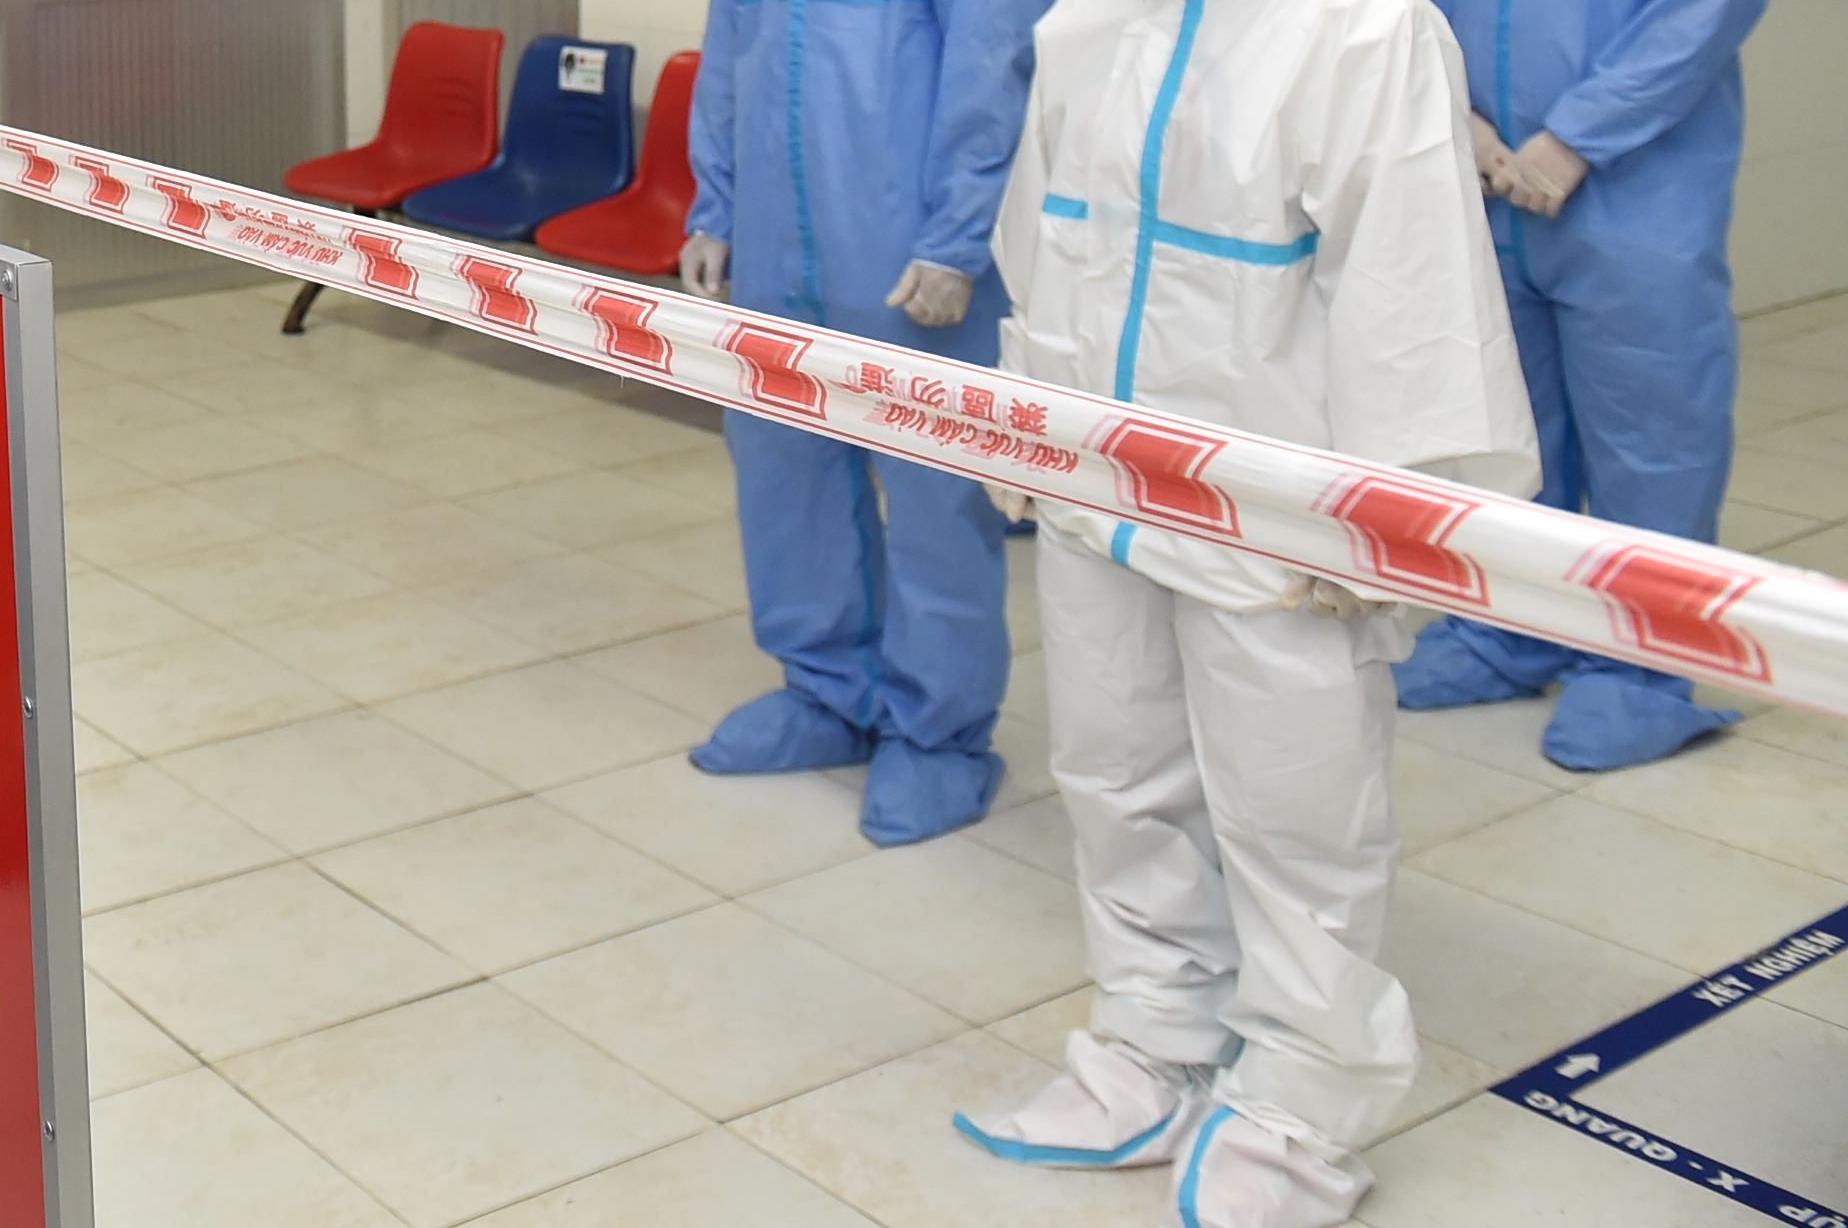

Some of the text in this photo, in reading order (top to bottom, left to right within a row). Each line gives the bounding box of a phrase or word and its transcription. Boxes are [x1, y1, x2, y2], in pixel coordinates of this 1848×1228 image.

[312, 248, 344, 266] KHU
[860, 361, 1049, 437] 禁區勿進
[884, 402, 927, 433] VÀO
[929, 415, 979, 447] CẤM
[1027, 442, 1080, 474] KHU
[1691, 974, 1755, 1008] XÉT
[1522, 1090, 1678, 1162] QUANG
[1706, 1169, 1751, 1193] X
